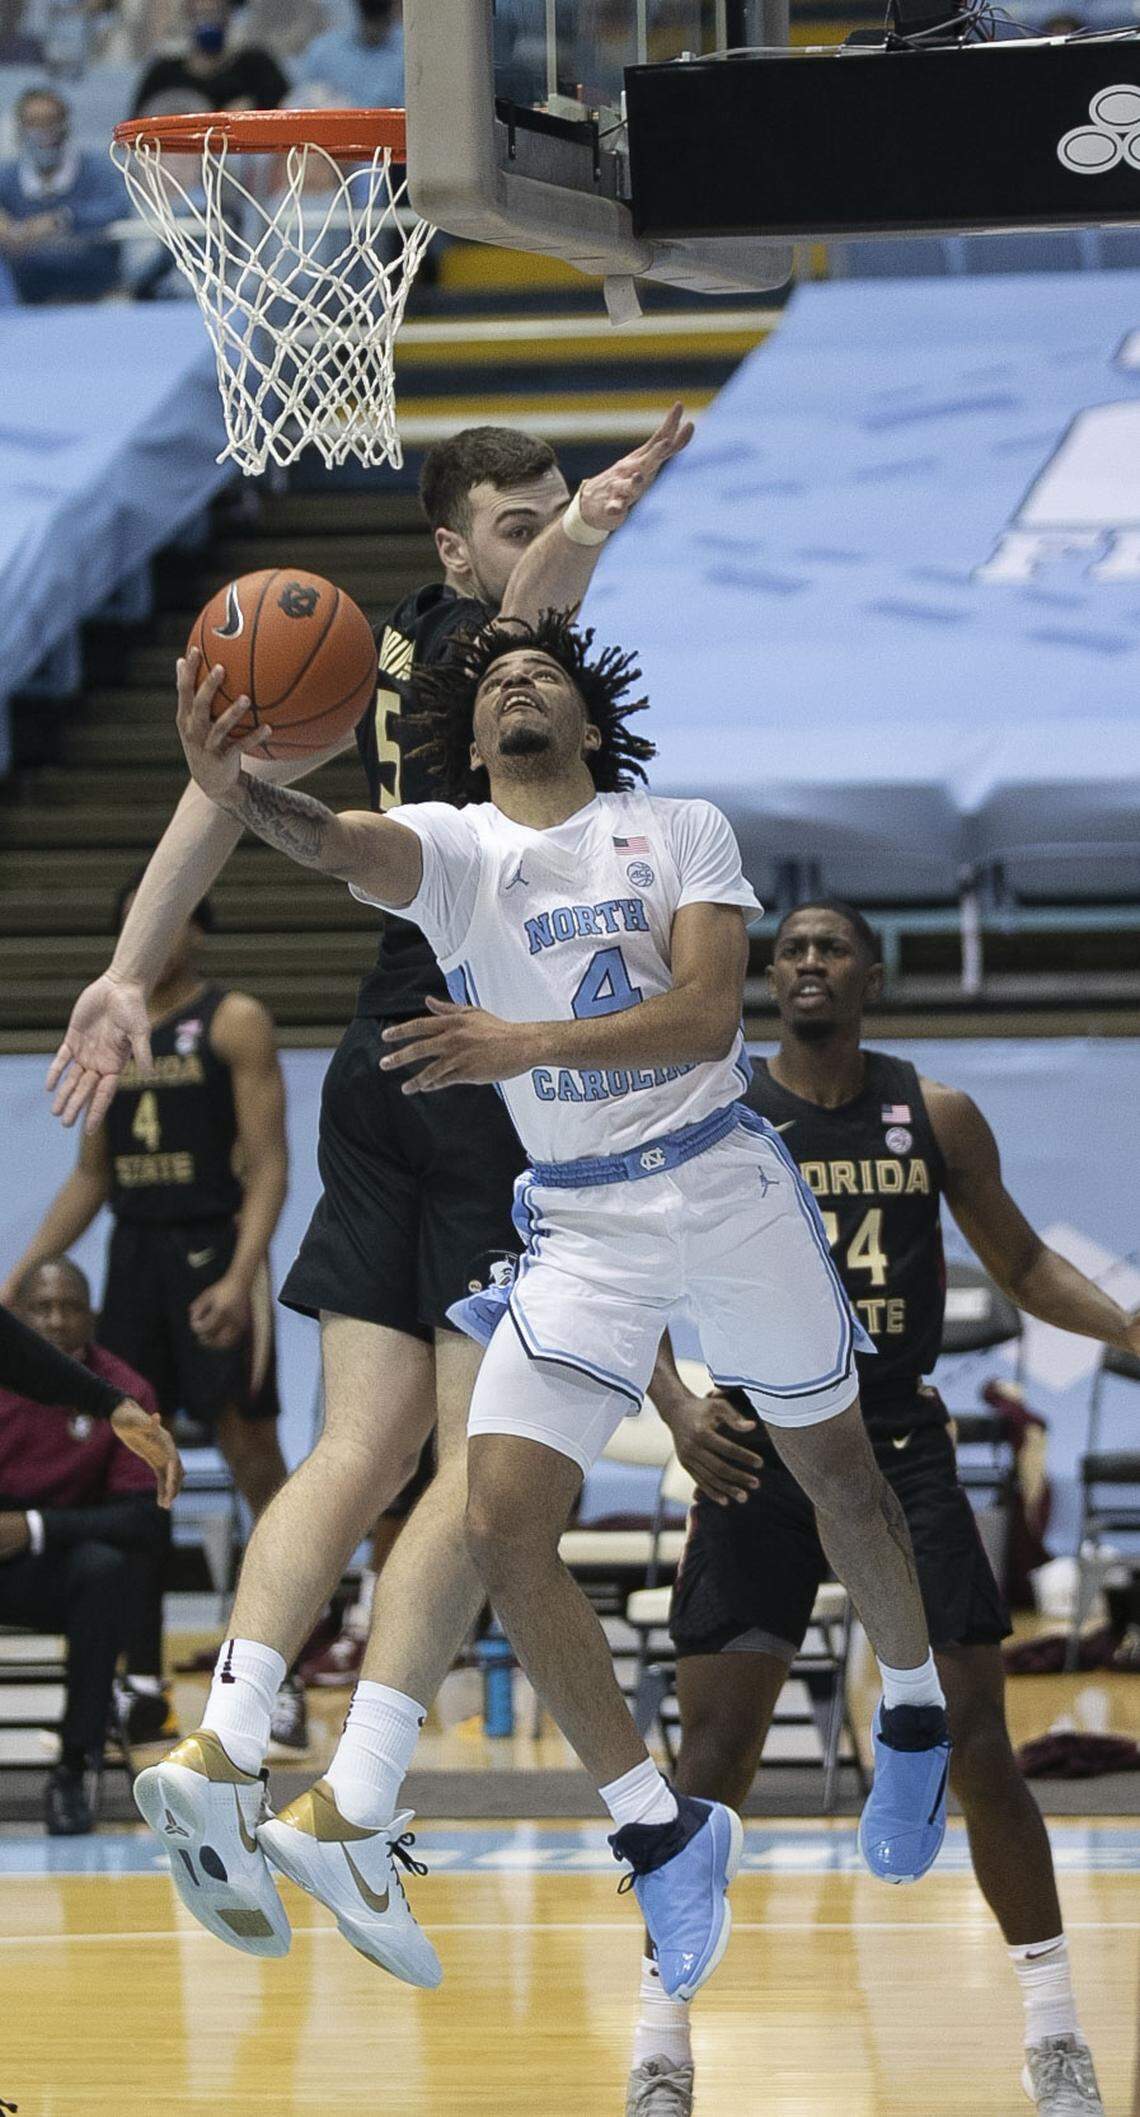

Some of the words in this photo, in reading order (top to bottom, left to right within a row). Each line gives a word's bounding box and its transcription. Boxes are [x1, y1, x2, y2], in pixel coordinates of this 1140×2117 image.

[375, 689, 401, 811] 5
[524, 898, 650, 955] NORTH
[571, 945, 643, 1019] 4
[532, 1062, 701, 1101] CAROLI
[132, 1089, 160, 1152] 4
[800, 1159, 930, 1195] ORIDA
